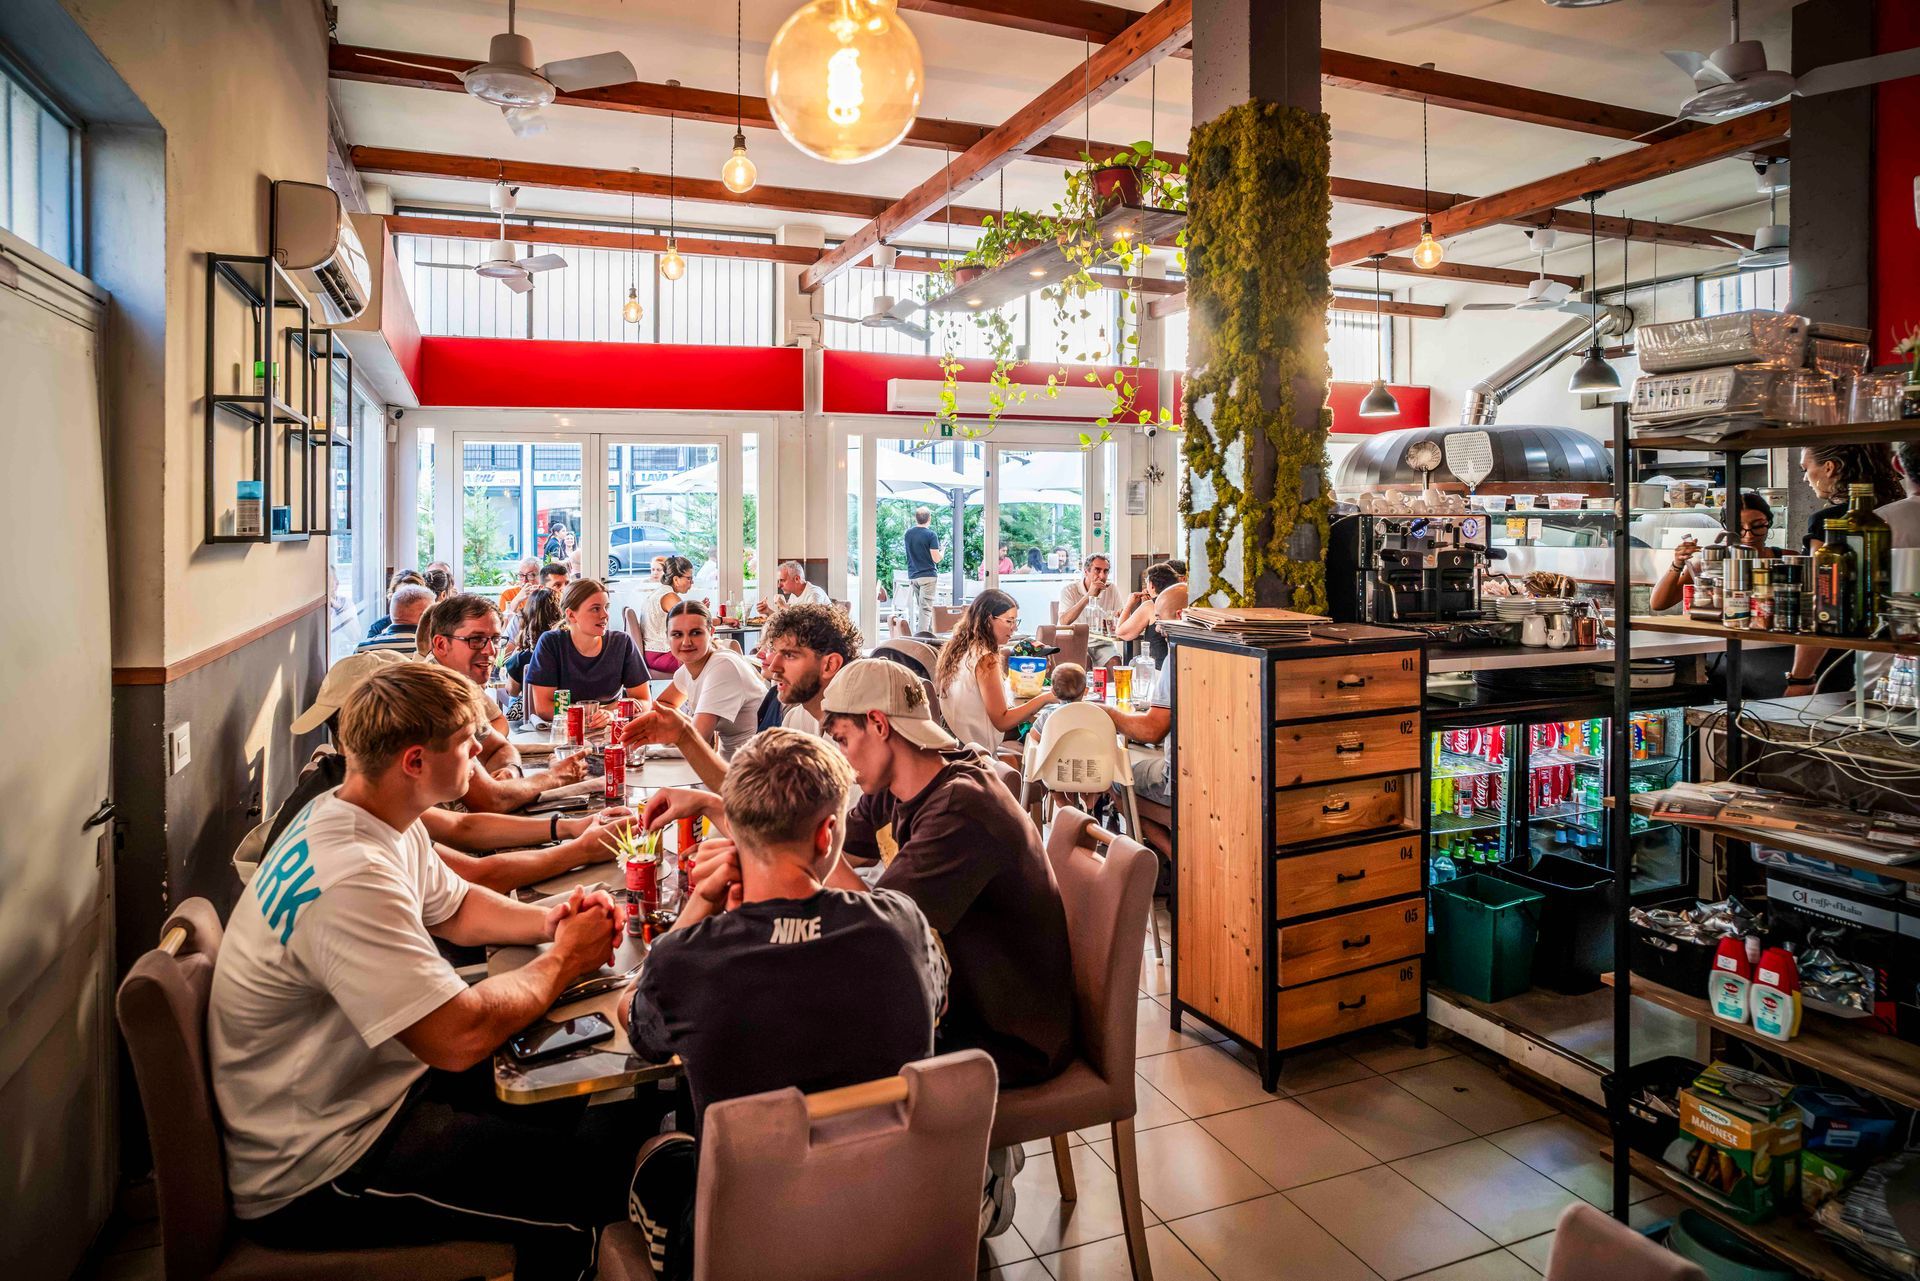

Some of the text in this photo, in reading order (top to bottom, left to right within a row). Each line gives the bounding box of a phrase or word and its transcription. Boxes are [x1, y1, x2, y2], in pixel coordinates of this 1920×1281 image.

[1401, 657, 1414, 671] 01
[1400, 720, 1414, 735] 02
[1384, 779, 1397, 793] 03
[1400, 846, 1413, 860] 04
[1404, 908, 1418, 924] 05
[769, 916, 822, 944] NIKE
[1400, 966, 1413, 982] 06
[1691, 1114, 1738, 1147] MAIONESE
